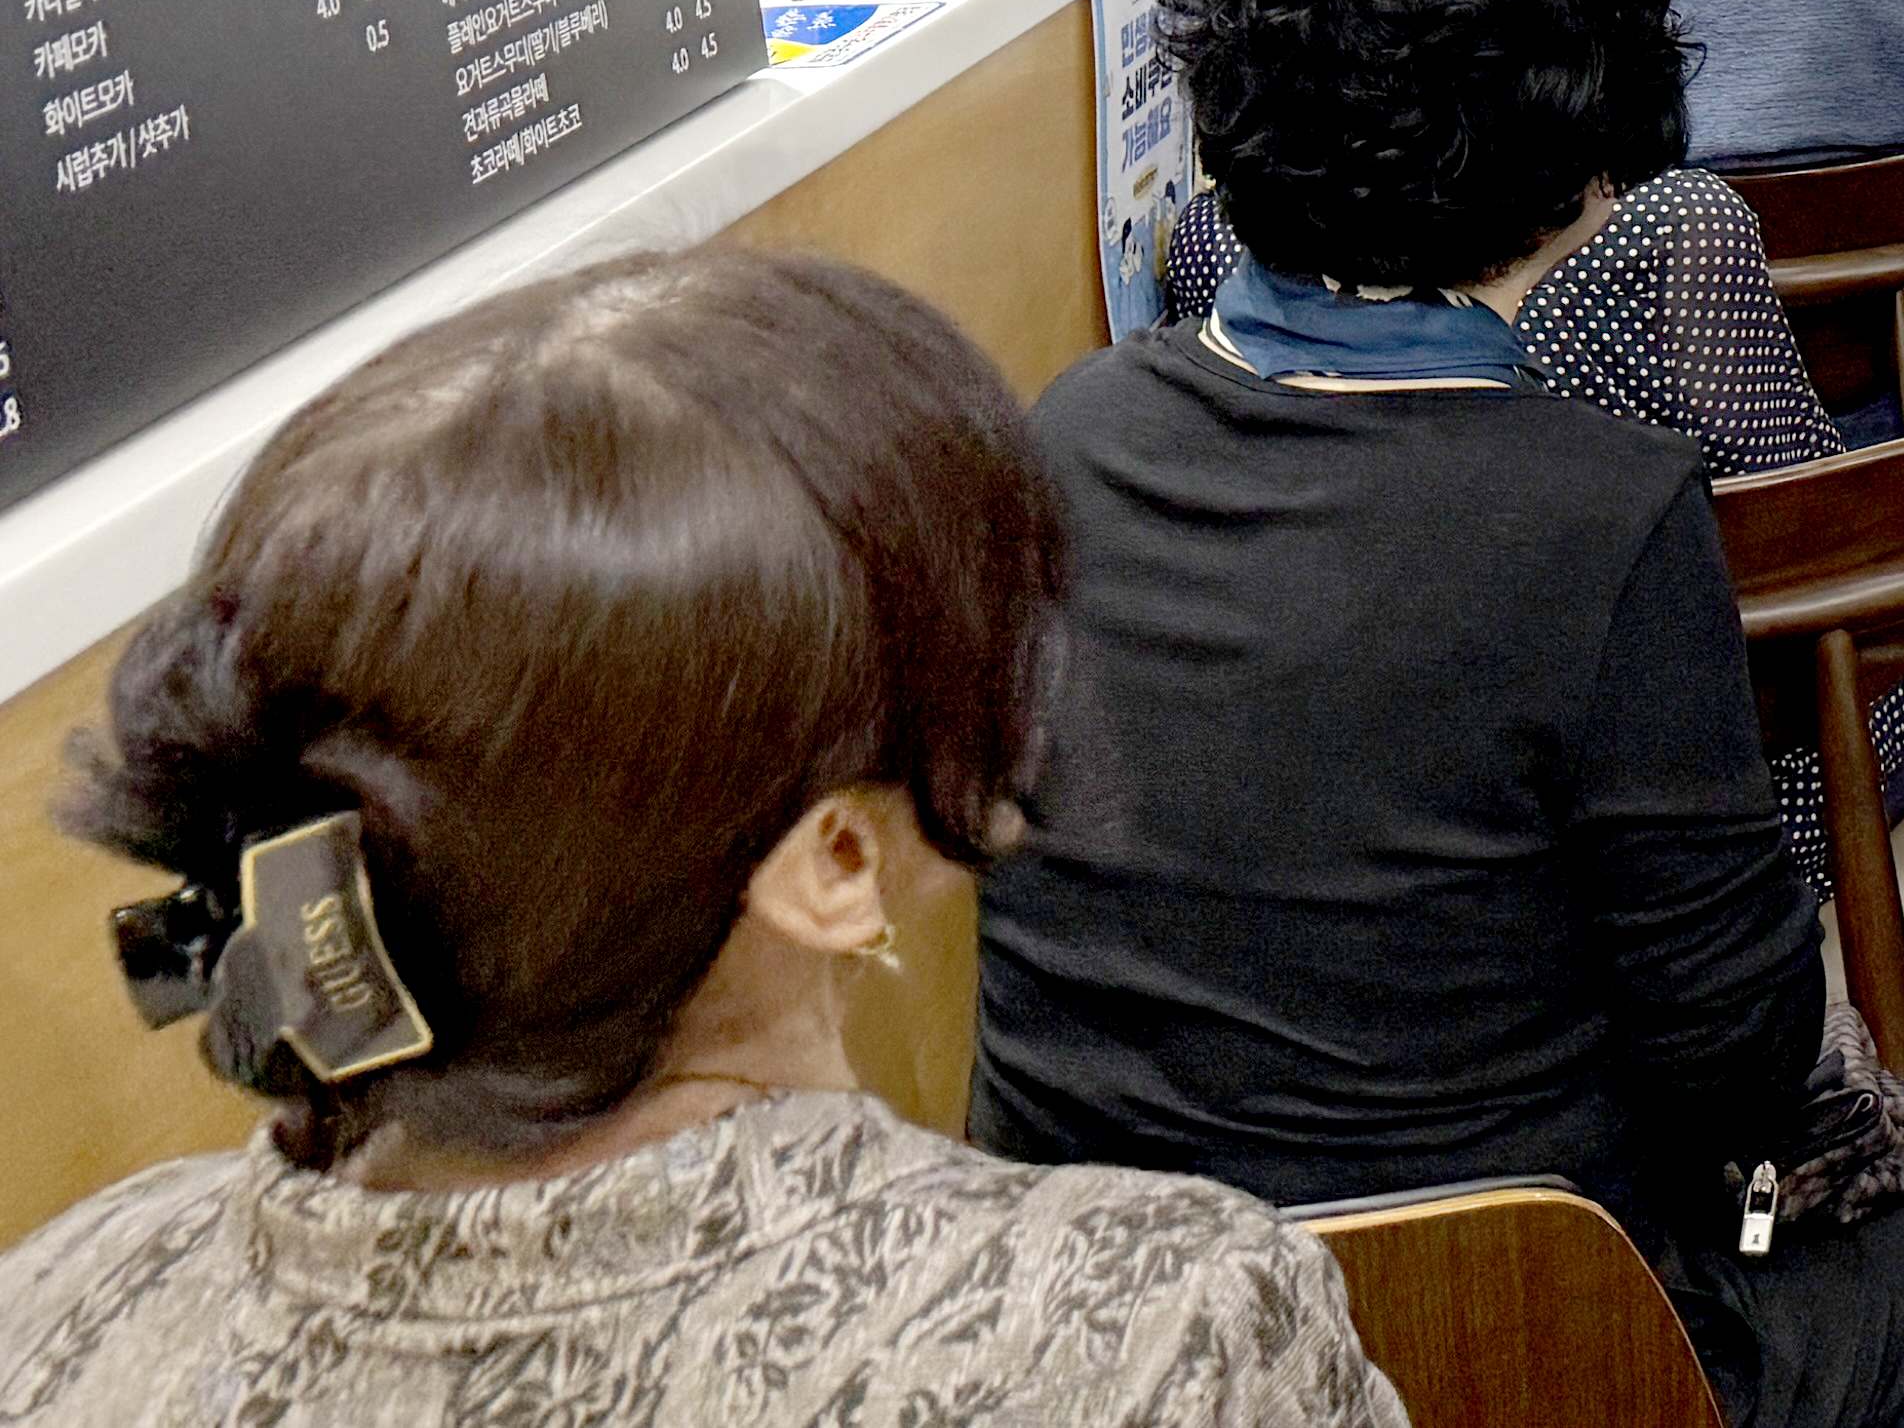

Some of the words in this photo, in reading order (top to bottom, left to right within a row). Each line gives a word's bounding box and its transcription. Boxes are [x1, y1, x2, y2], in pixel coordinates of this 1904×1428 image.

[33, 20, 108, 80] 카페모카
[41, 69, 136, 136] 화이트모카
[462, 73, 550, 143] 견과류곡물라떼
[55, 130, 130, 193] 시럽추가
[138, 103, 191, 159] 샷추가
[469, 103, 583, 186] 초코라떼/화이트초코
